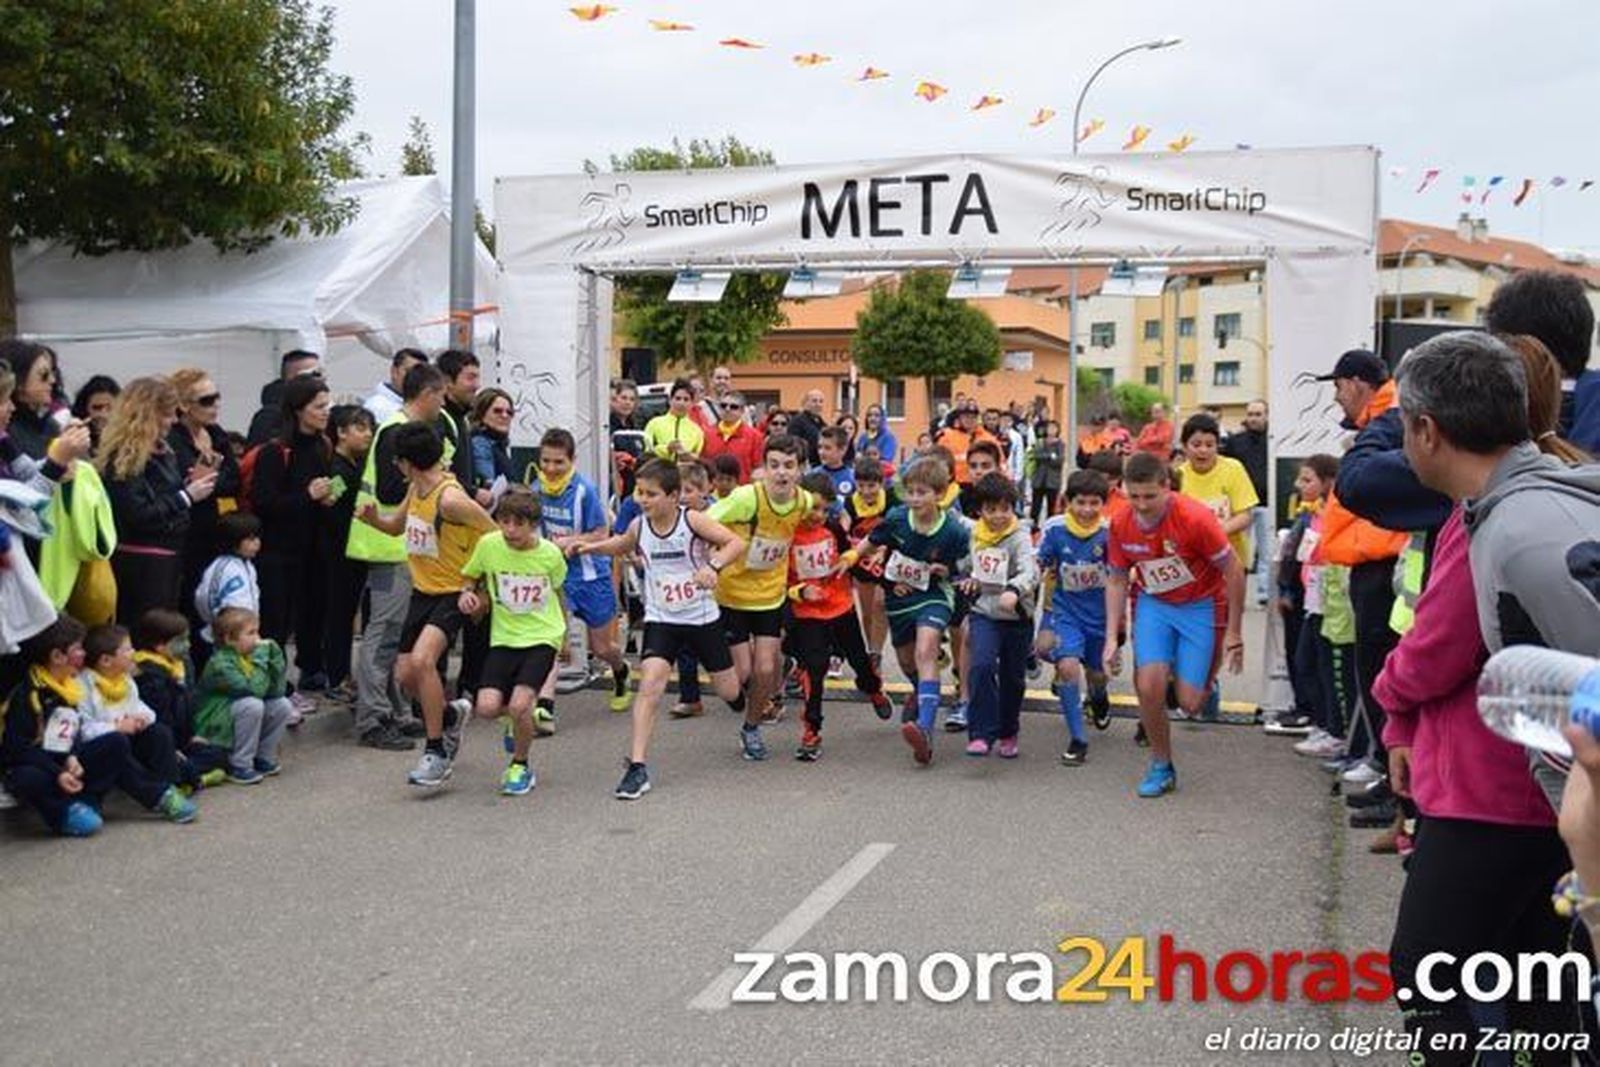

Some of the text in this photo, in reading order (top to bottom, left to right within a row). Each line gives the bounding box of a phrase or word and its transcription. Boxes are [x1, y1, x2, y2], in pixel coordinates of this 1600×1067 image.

[801, 172, 999, 240] META
[1127, 187, 1266, 216] SmartChip
[644, 201, 768, 227] SmartChip
[1150, 565, 1181, 584] 153
[510, 585, 542, 603] 172
[663, 581, 694, 603] 216
